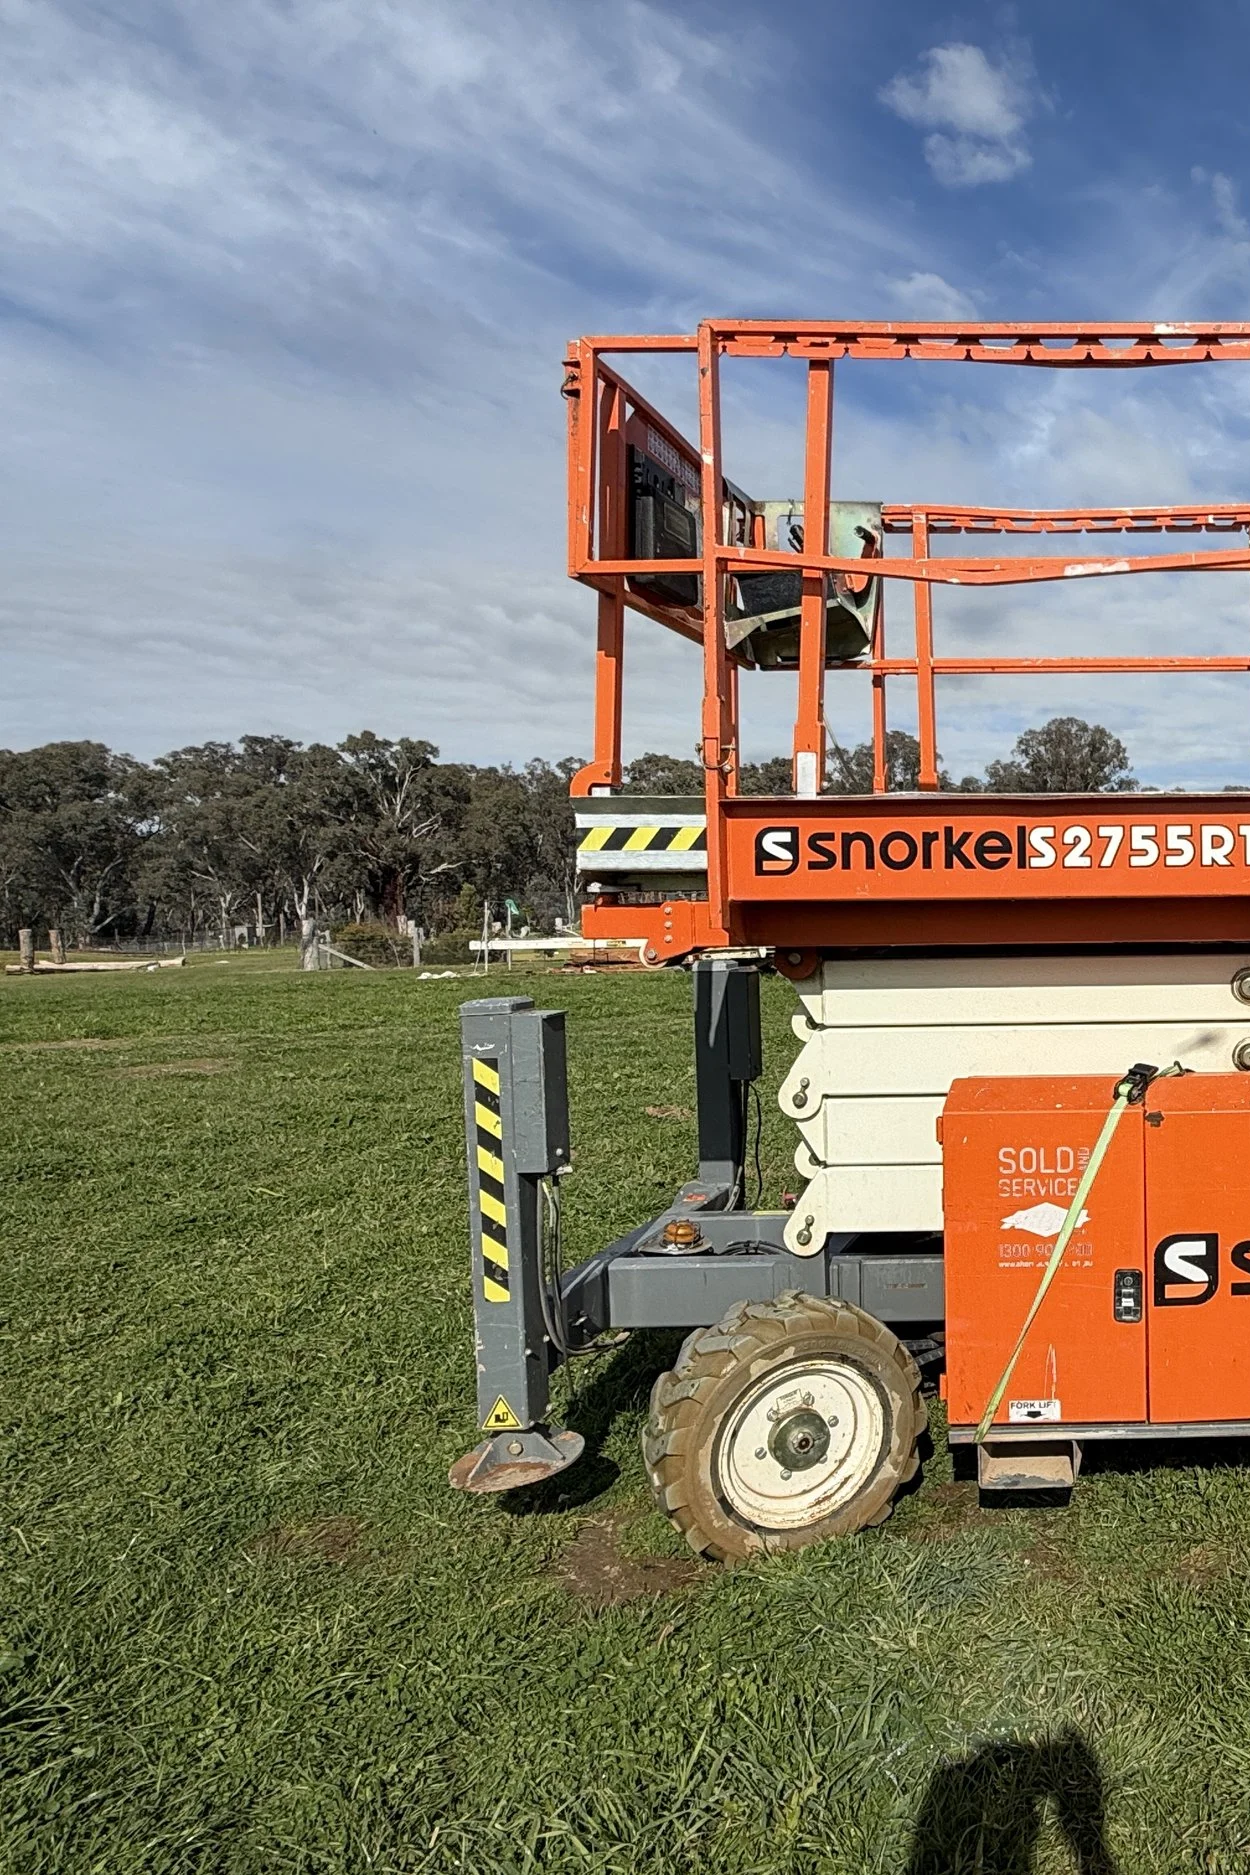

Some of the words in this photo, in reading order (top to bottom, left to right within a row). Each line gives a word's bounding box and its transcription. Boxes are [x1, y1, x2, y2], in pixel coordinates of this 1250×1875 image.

[807, 825, 1027, 871] snorkel
[998, 1146, 1074, 1175] SOLD
[998, 1178, 1082, 1198] SERVICE
[1010, 1401, 1036, 1410] FORK
